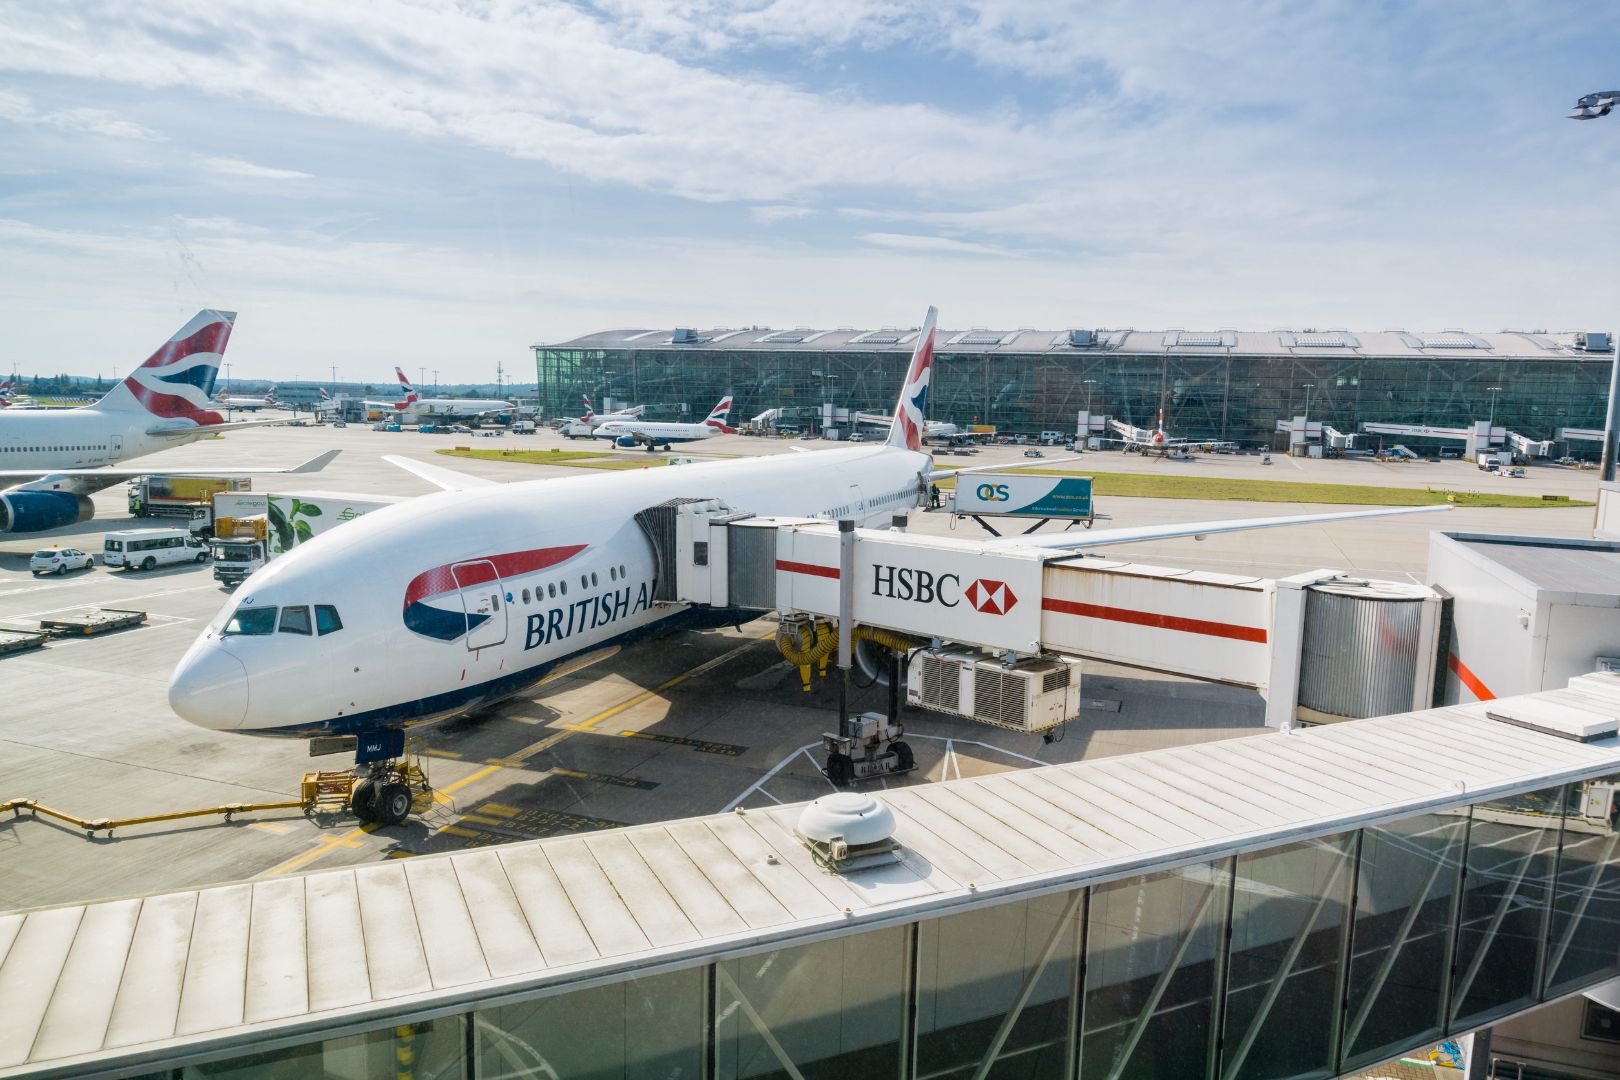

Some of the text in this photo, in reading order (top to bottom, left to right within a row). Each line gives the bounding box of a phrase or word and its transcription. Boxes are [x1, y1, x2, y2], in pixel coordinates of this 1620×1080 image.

[976, 483, 1010, 501] OCS
[872, 564, 960, 608] HSBC
[524, 586, 631, 651] BRITISH
